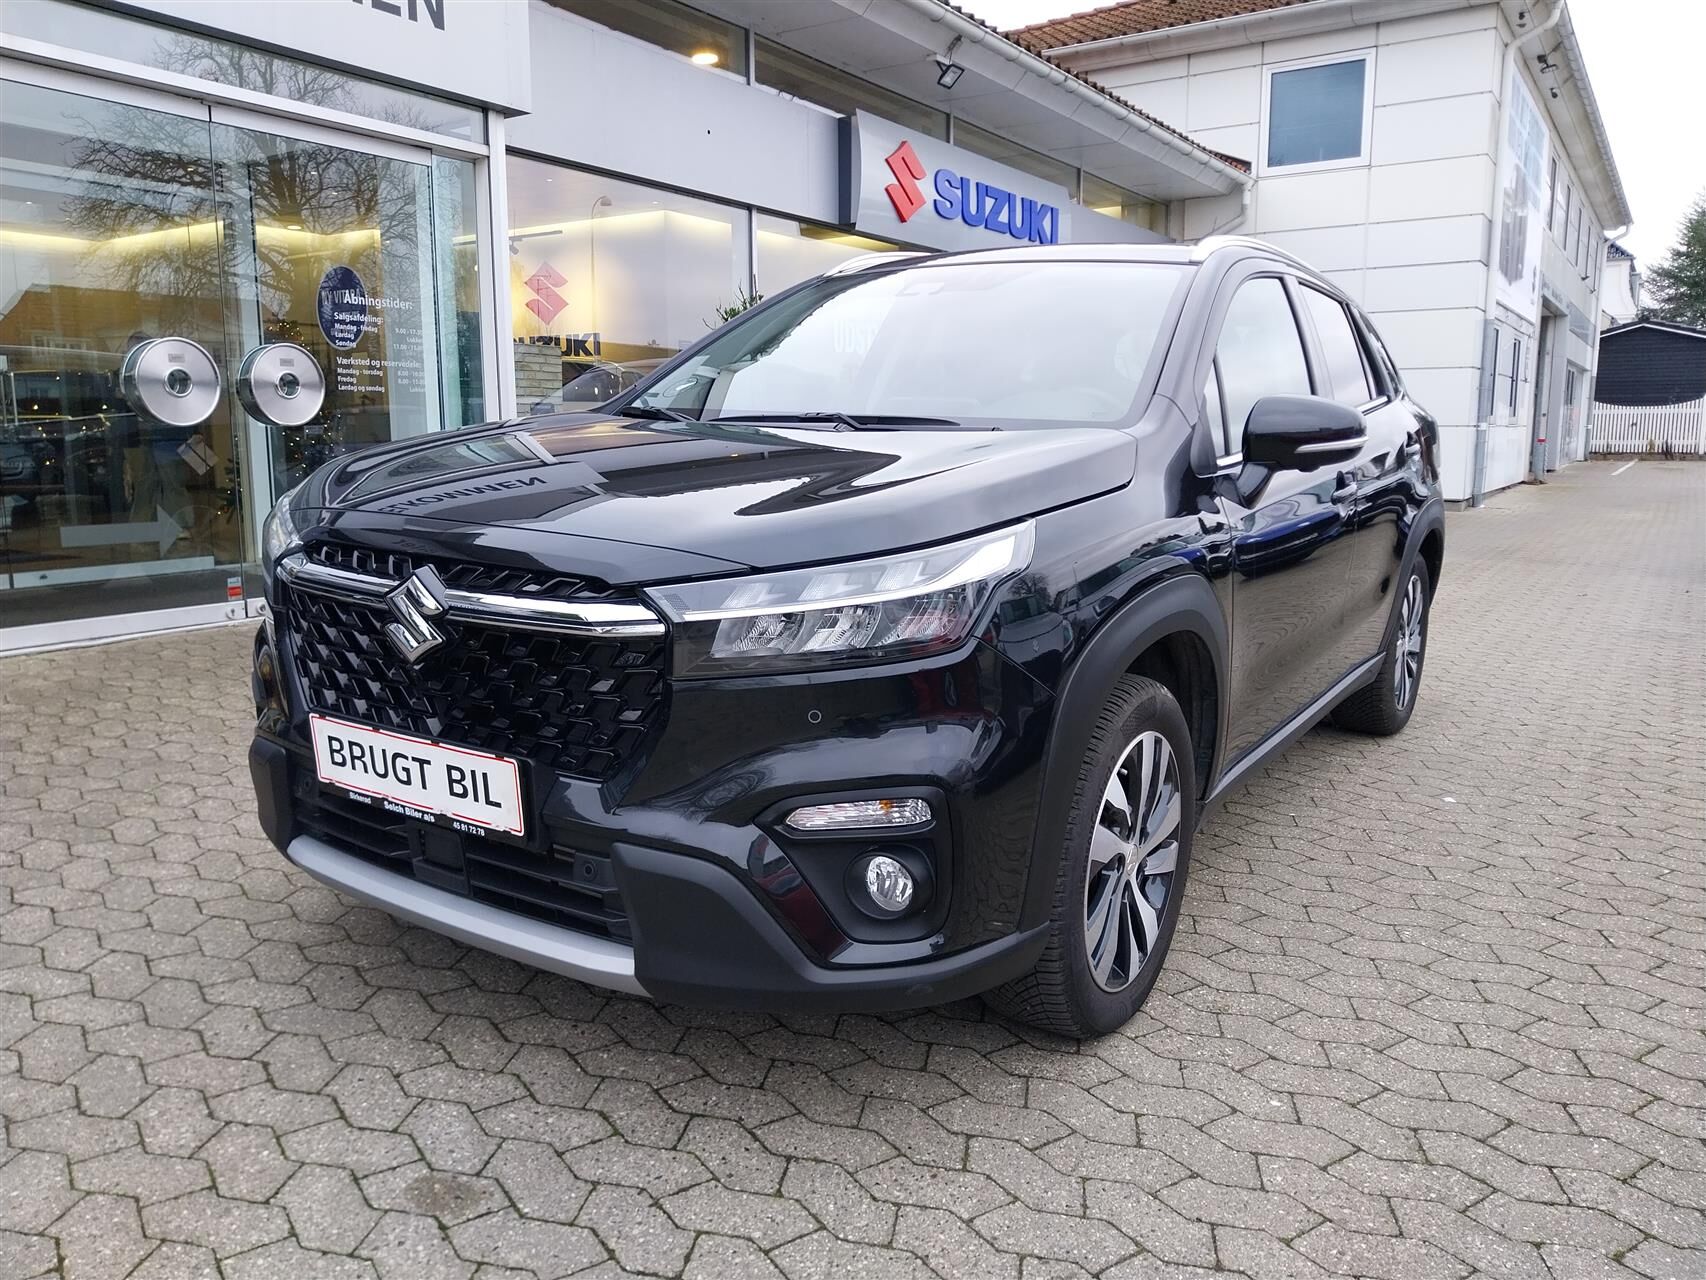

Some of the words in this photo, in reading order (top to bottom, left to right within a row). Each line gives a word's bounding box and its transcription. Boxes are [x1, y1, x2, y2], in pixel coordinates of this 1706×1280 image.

[933, 169, 1059, 245] SUZUKI
[334, 323, 357, 331] Mandag
[336, 357, 370, 366] Værksted
[371, 360, 380, 368] og
[327, 735, 432, 791] BRUGT
[446, 763, 503, 809] BIL
[405, 806, 423, 819] Biler
